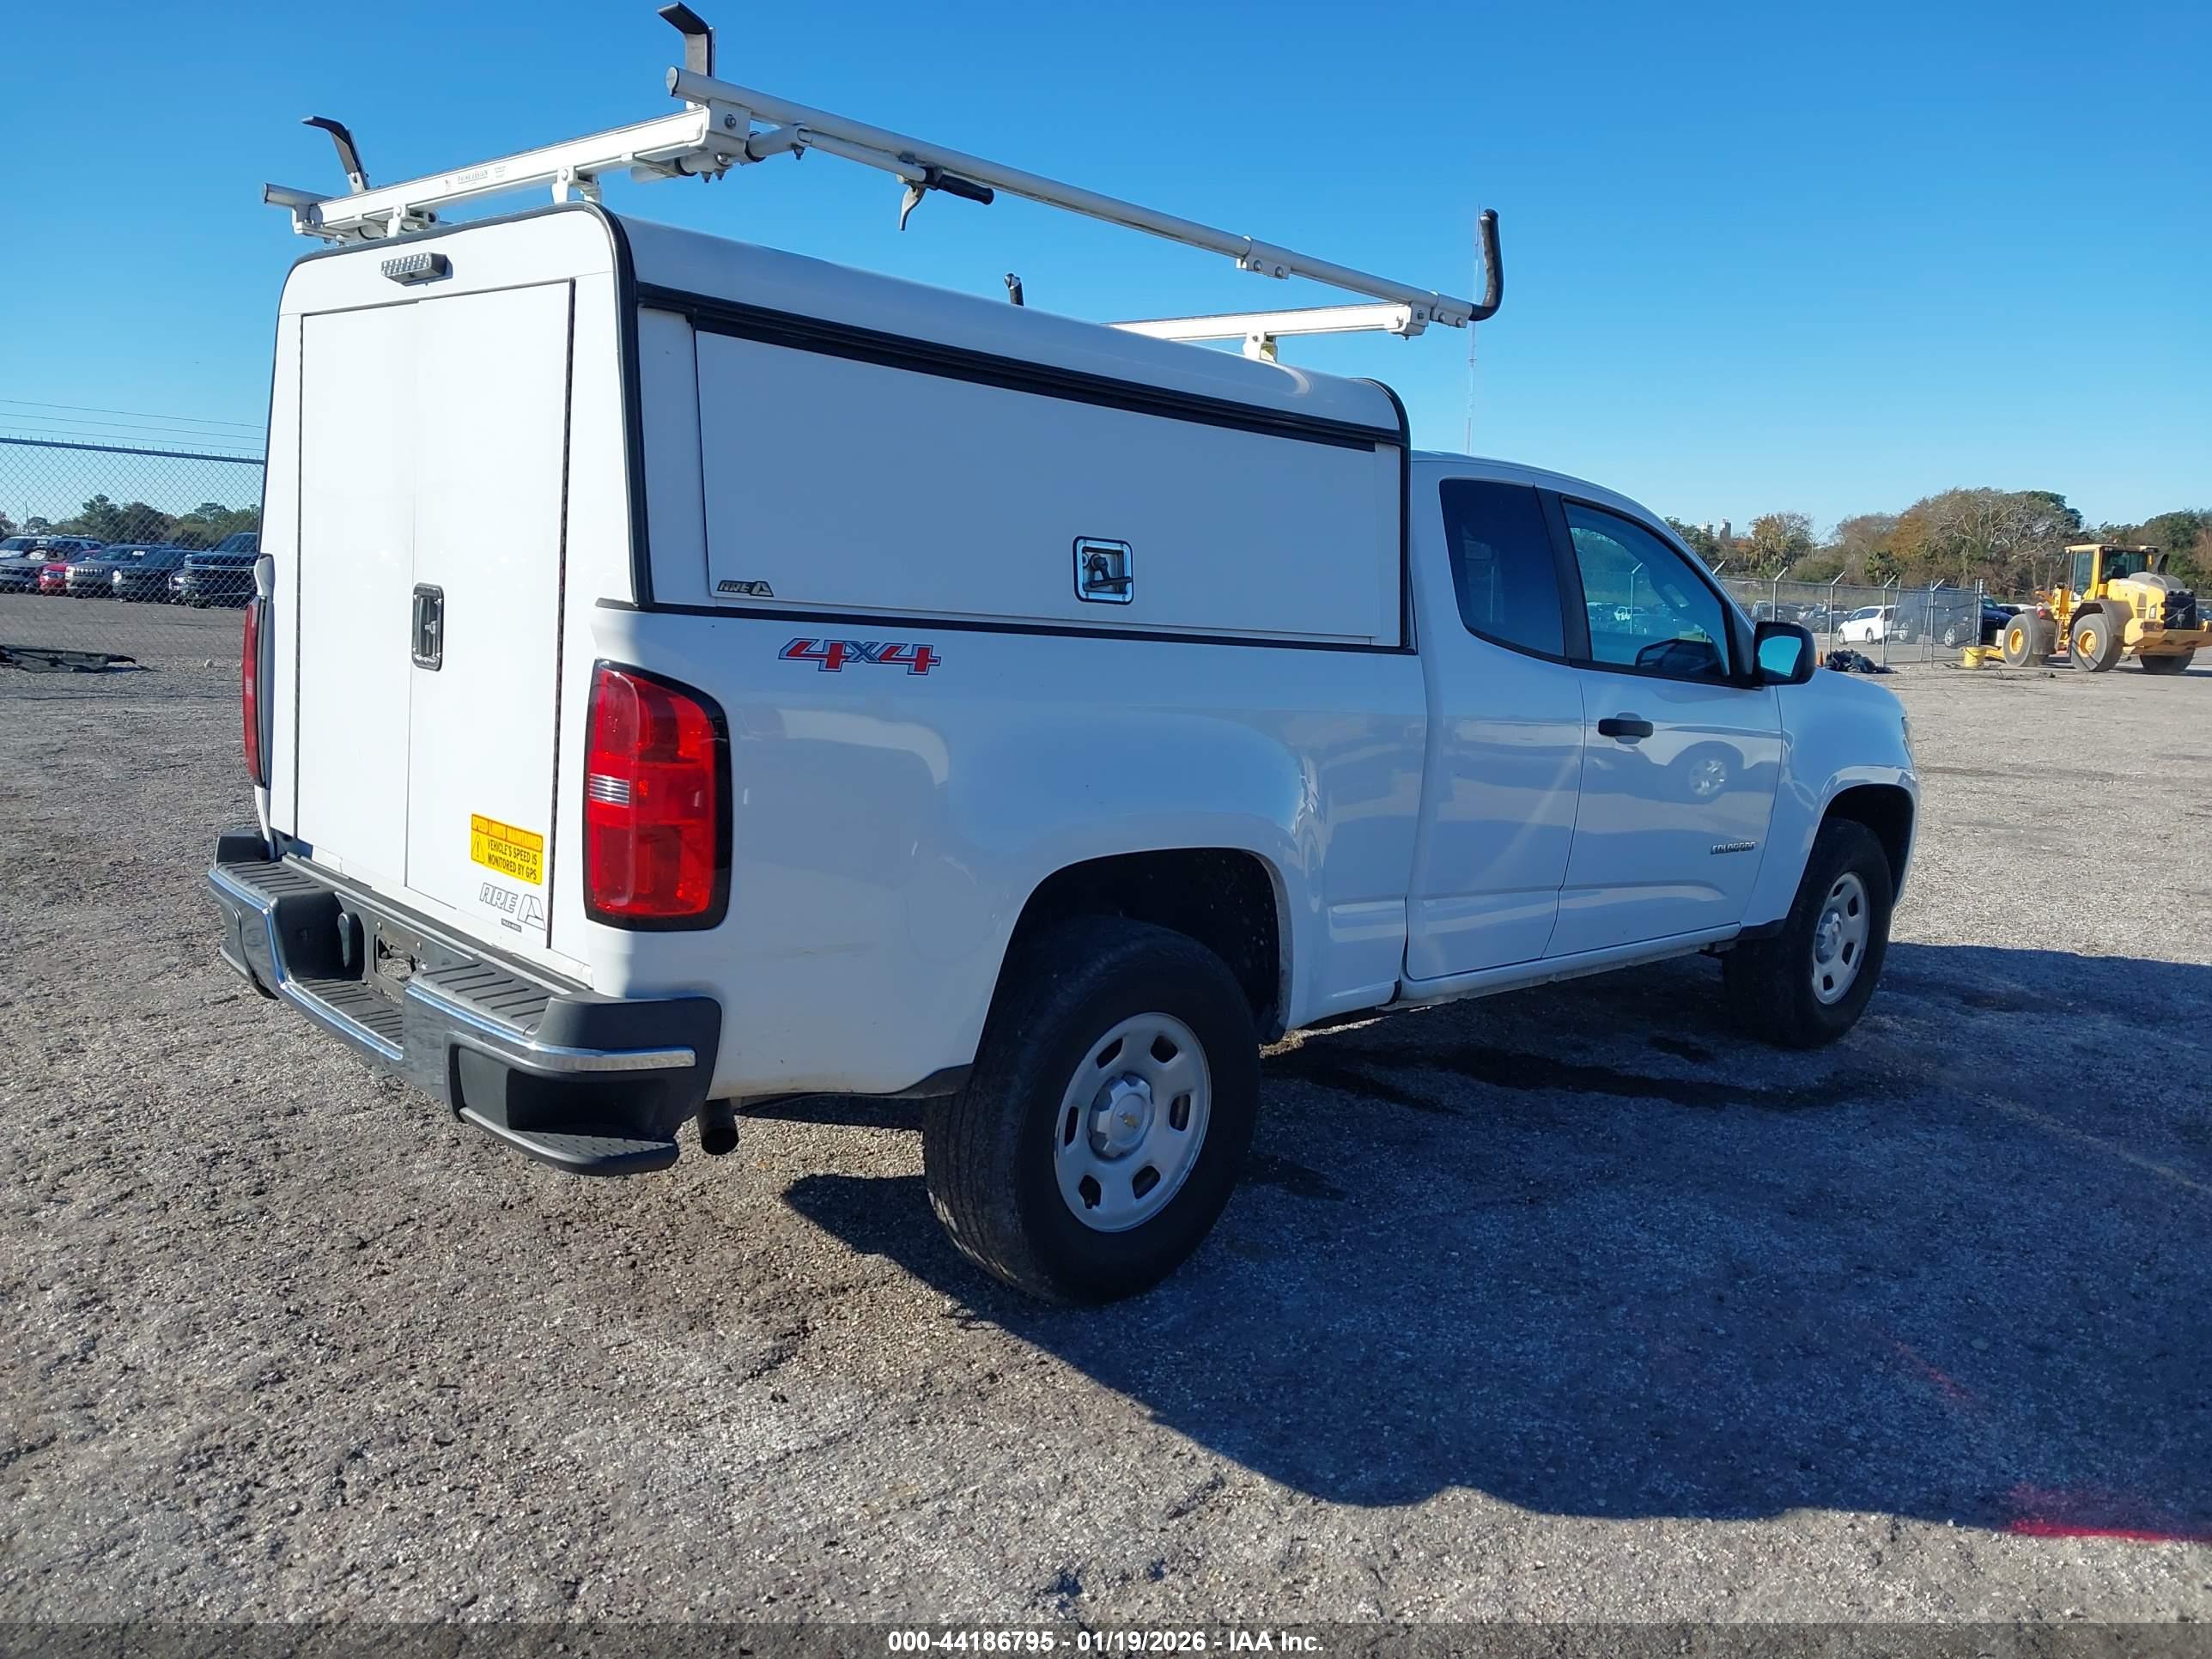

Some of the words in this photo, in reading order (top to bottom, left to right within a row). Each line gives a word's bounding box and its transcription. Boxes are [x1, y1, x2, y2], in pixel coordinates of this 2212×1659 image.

[488, 837, 512, 857] VEHICLE'S
[513, 847, 531, 864] SPEED
[532, 852, 538, 866] IS
[488, 852, 517, 873] MONITORED
[518, 863, 525, 876] BY
[526, 866, 538, 880] GPS
[479, 882, 519, 914] ARE
